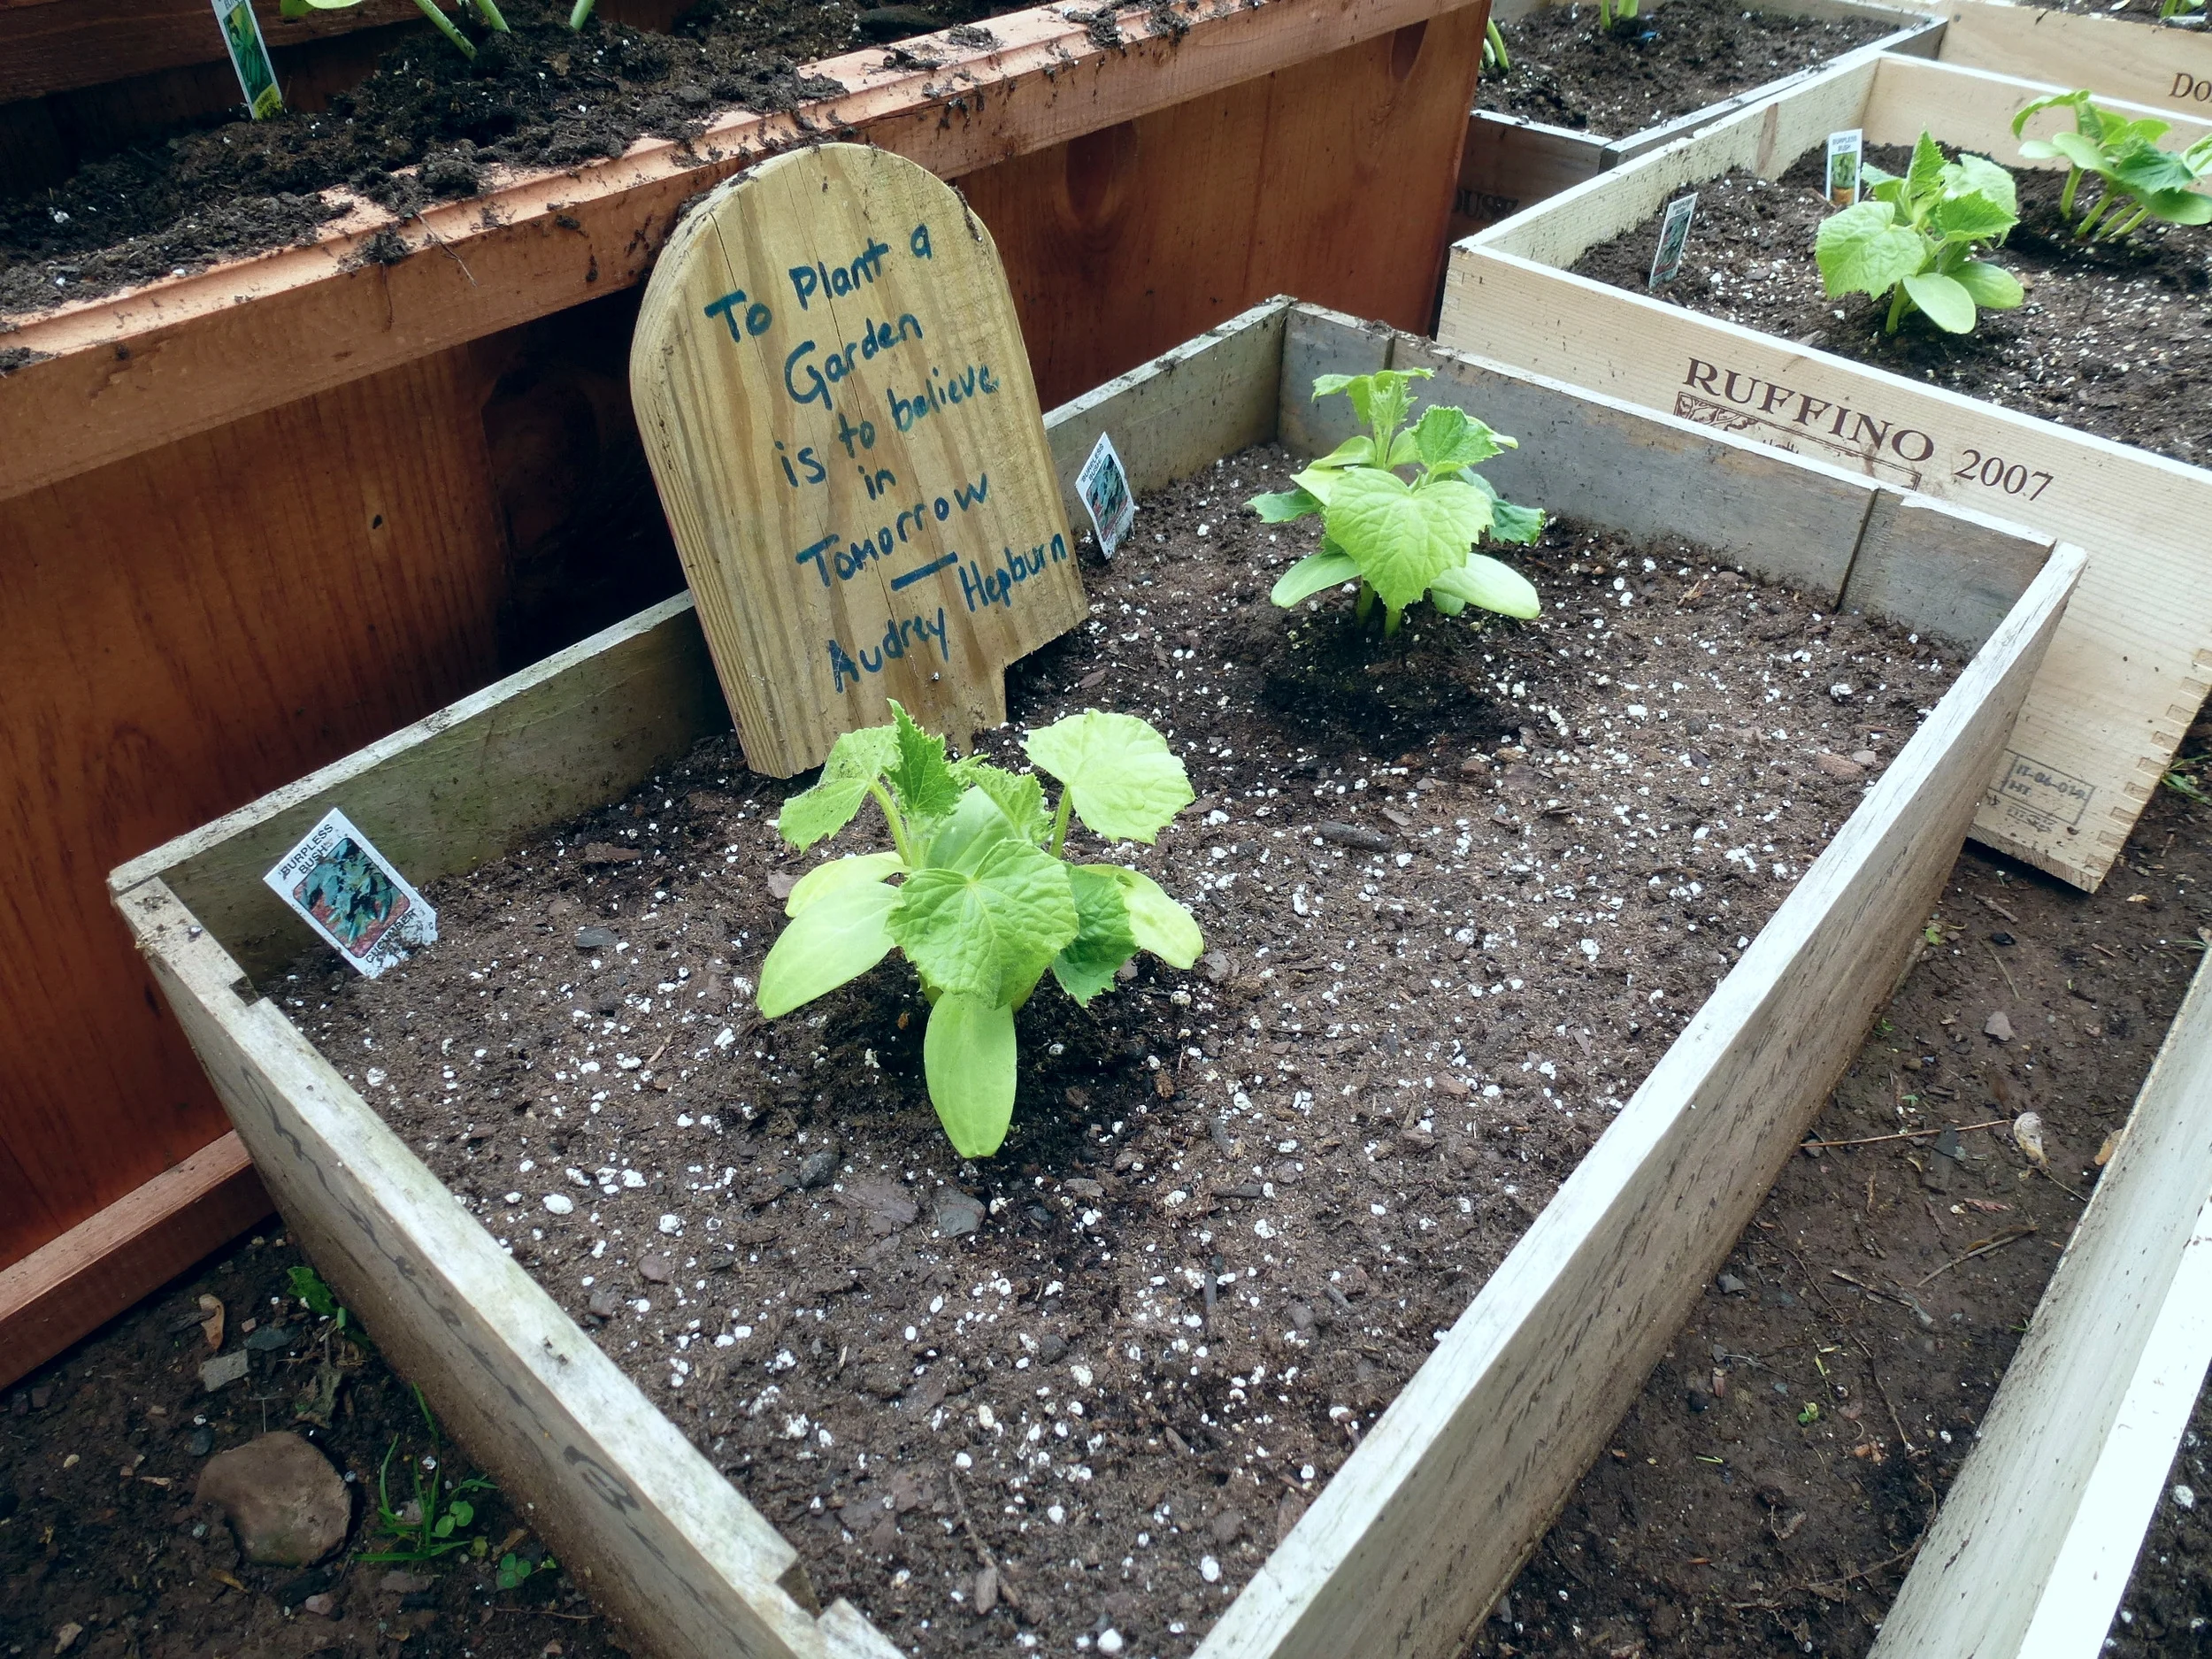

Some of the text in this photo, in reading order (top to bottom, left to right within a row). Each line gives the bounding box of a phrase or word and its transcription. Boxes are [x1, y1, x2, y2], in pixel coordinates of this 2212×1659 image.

[704, 223, 933, 343] To Plant a
[784, 313, 924, 411] Garden
[774, 364, 1000, 488] is to believe
[857, 465, 897, 501] in
[1682, 357, 2055, 502] RUFFINO 2007
[795, 472, 988, 588] Tomorrow
[827, 532, 1067, 694] Audrey Hepburn
